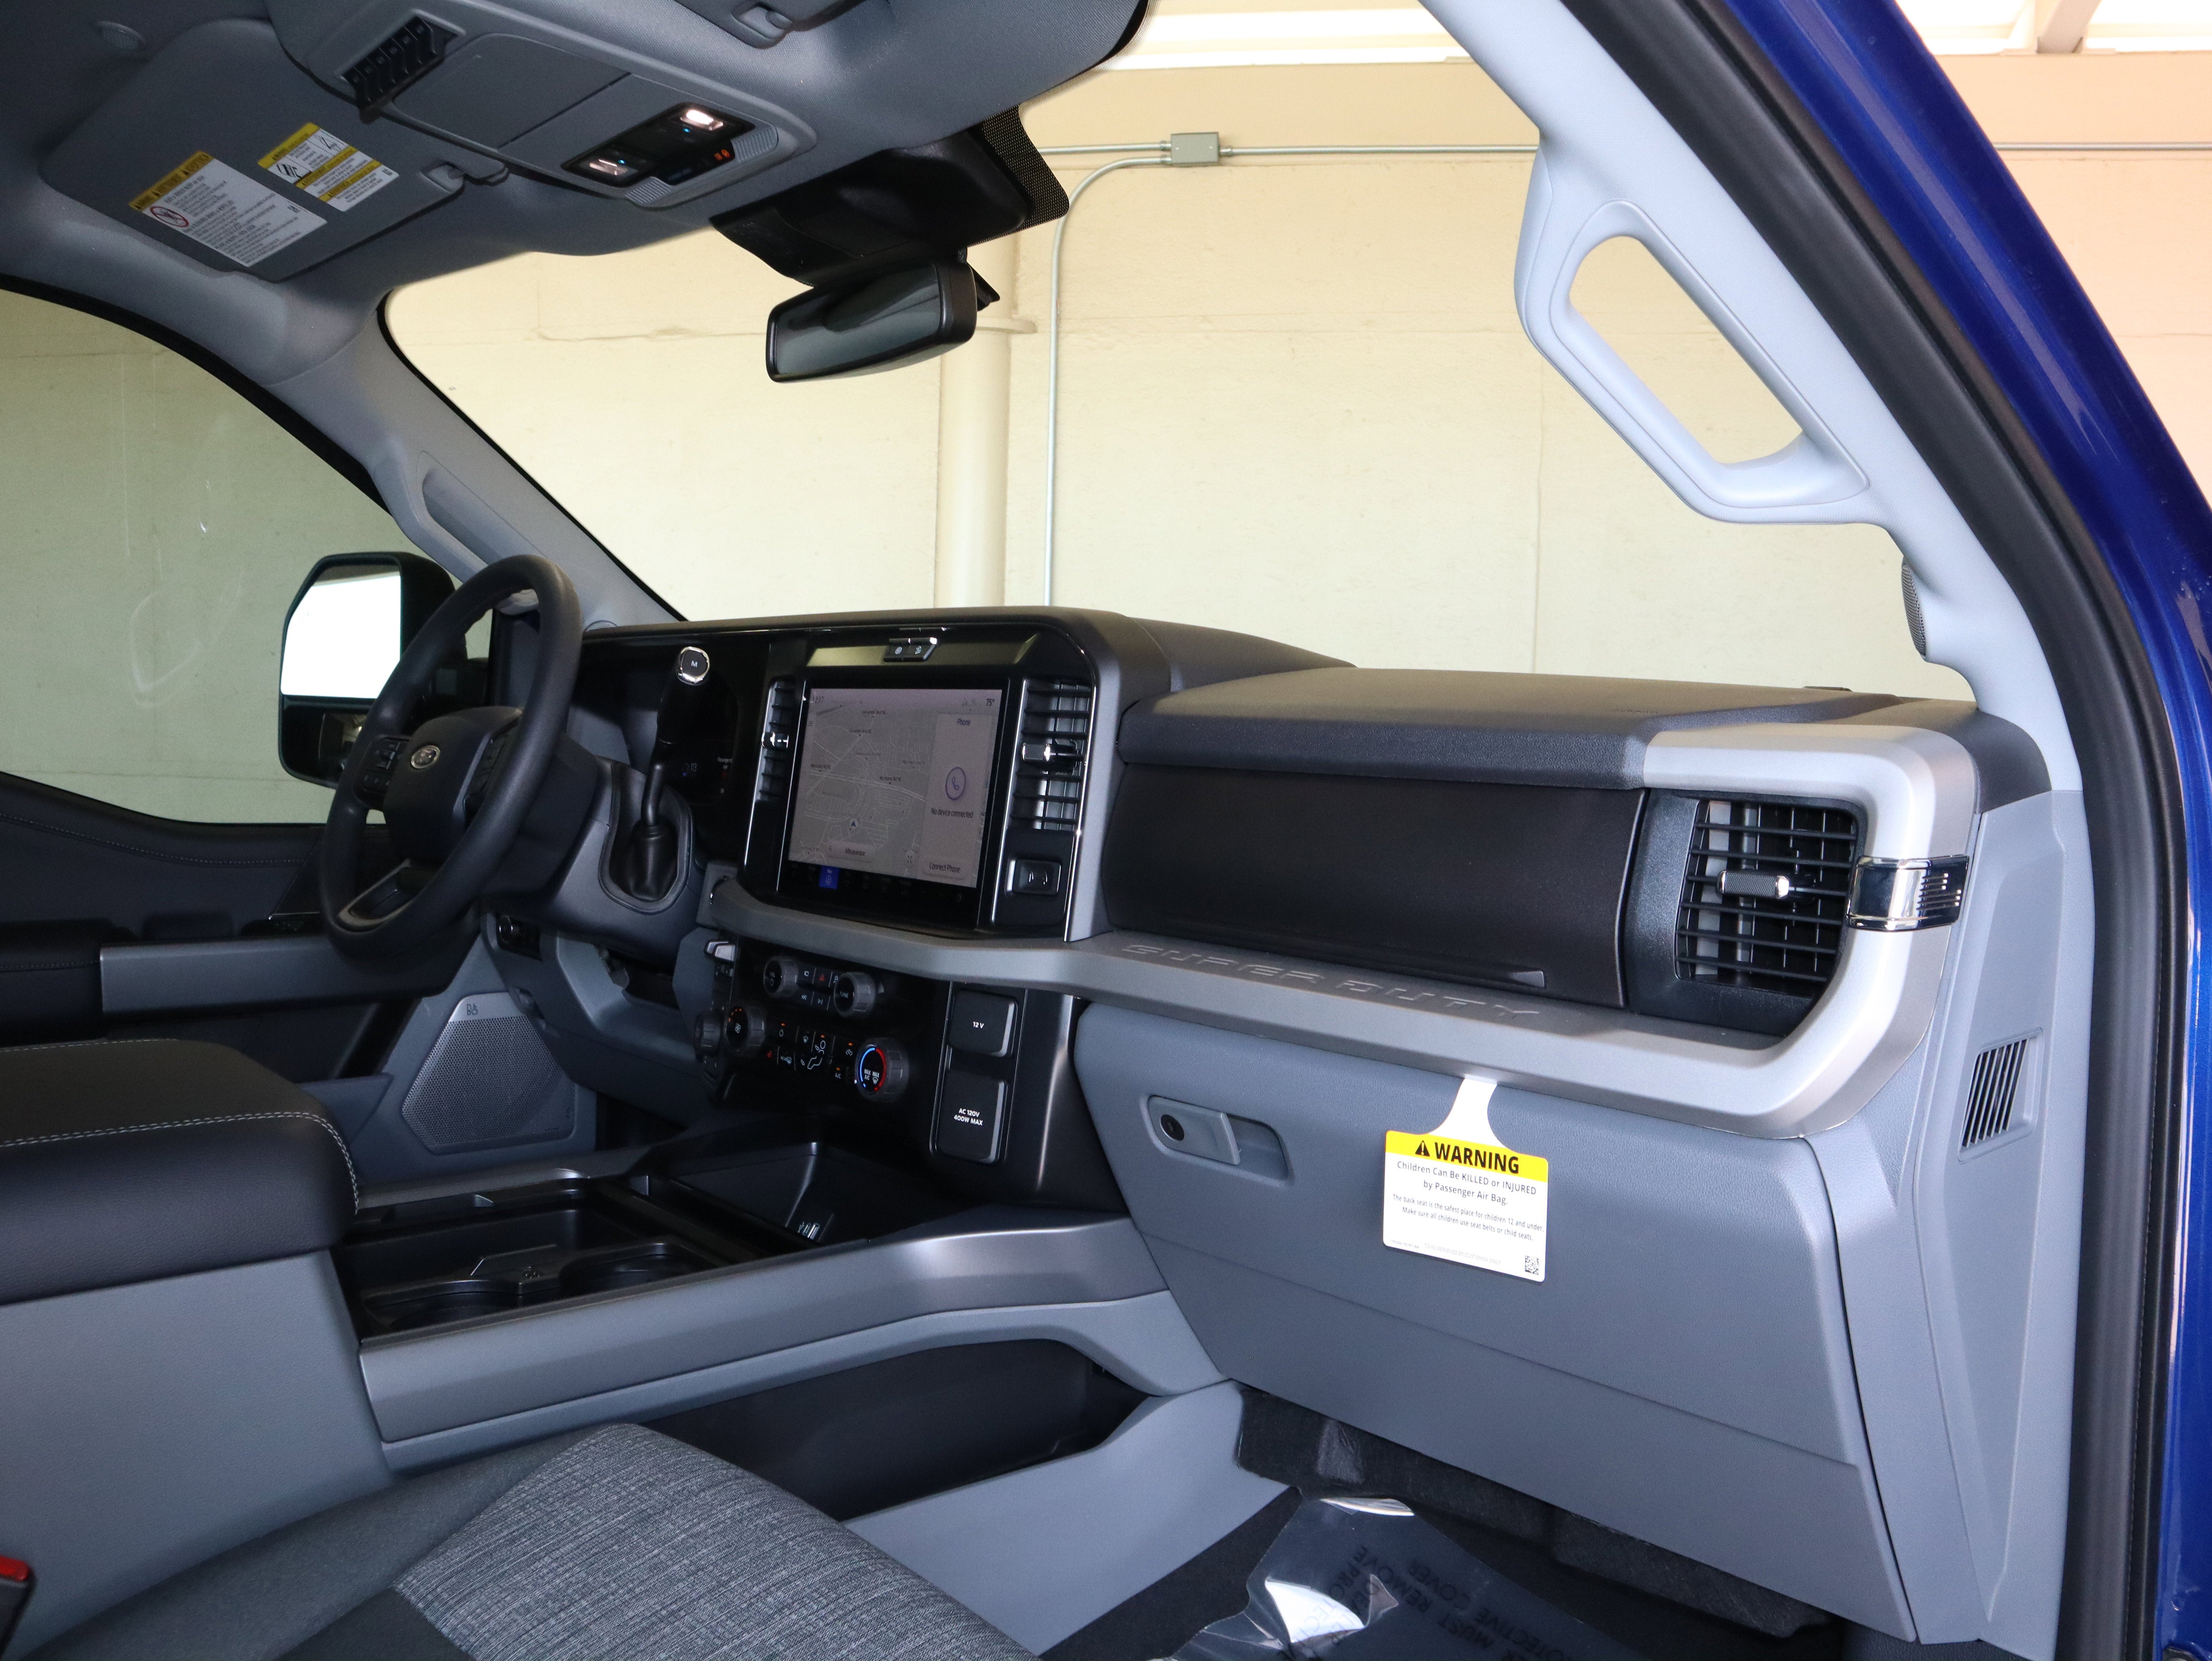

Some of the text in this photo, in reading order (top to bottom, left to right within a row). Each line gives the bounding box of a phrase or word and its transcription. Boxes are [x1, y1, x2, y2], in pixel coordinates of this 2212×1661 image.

[957, 718, 971, 726] Phone
[929, 862, 961, 873] Connect Phone
[1122, 944, 1540, 1019] SUPER DUTY
[954, 1115, 970, 1123] 400W
[1434, 1142, 1519, 1174] WARNING
[1397, 1161, 1430, 1174] Children
[1433, 1167, 1447, 1177] Can
[1450, 1170, 1460, 1180] Be
[1462, 1173, 1489, 1185] KILLED
[1502, 1181, 1537, 1195] INJURED
[1424, 1179, 1508, 1206] by Passenger Air Bag.
[1393, 1193, 1402, 1202] The
[1403, 1196, 1415, 1204] back
[1444, 1205, 1459, 1214] safest
[1461, 1208, 1474, 1217] place
[1484, 1213, 1506, 1223] children
[1527, 1223, 1544, 1232] under.
[1402, 1206, 1417, 1215] Make
[1438, 1214, 1458, 1224] children
[1483, 1223, 1495, 1232] belts
[1504, 1228, 1517, 1237] child
[1518, 1232, 1534, 1241] seats.
[1437, 1246, 1458, 1255] REMOVED
[1465, 1252, 1488, 1262] CUSTOMER
